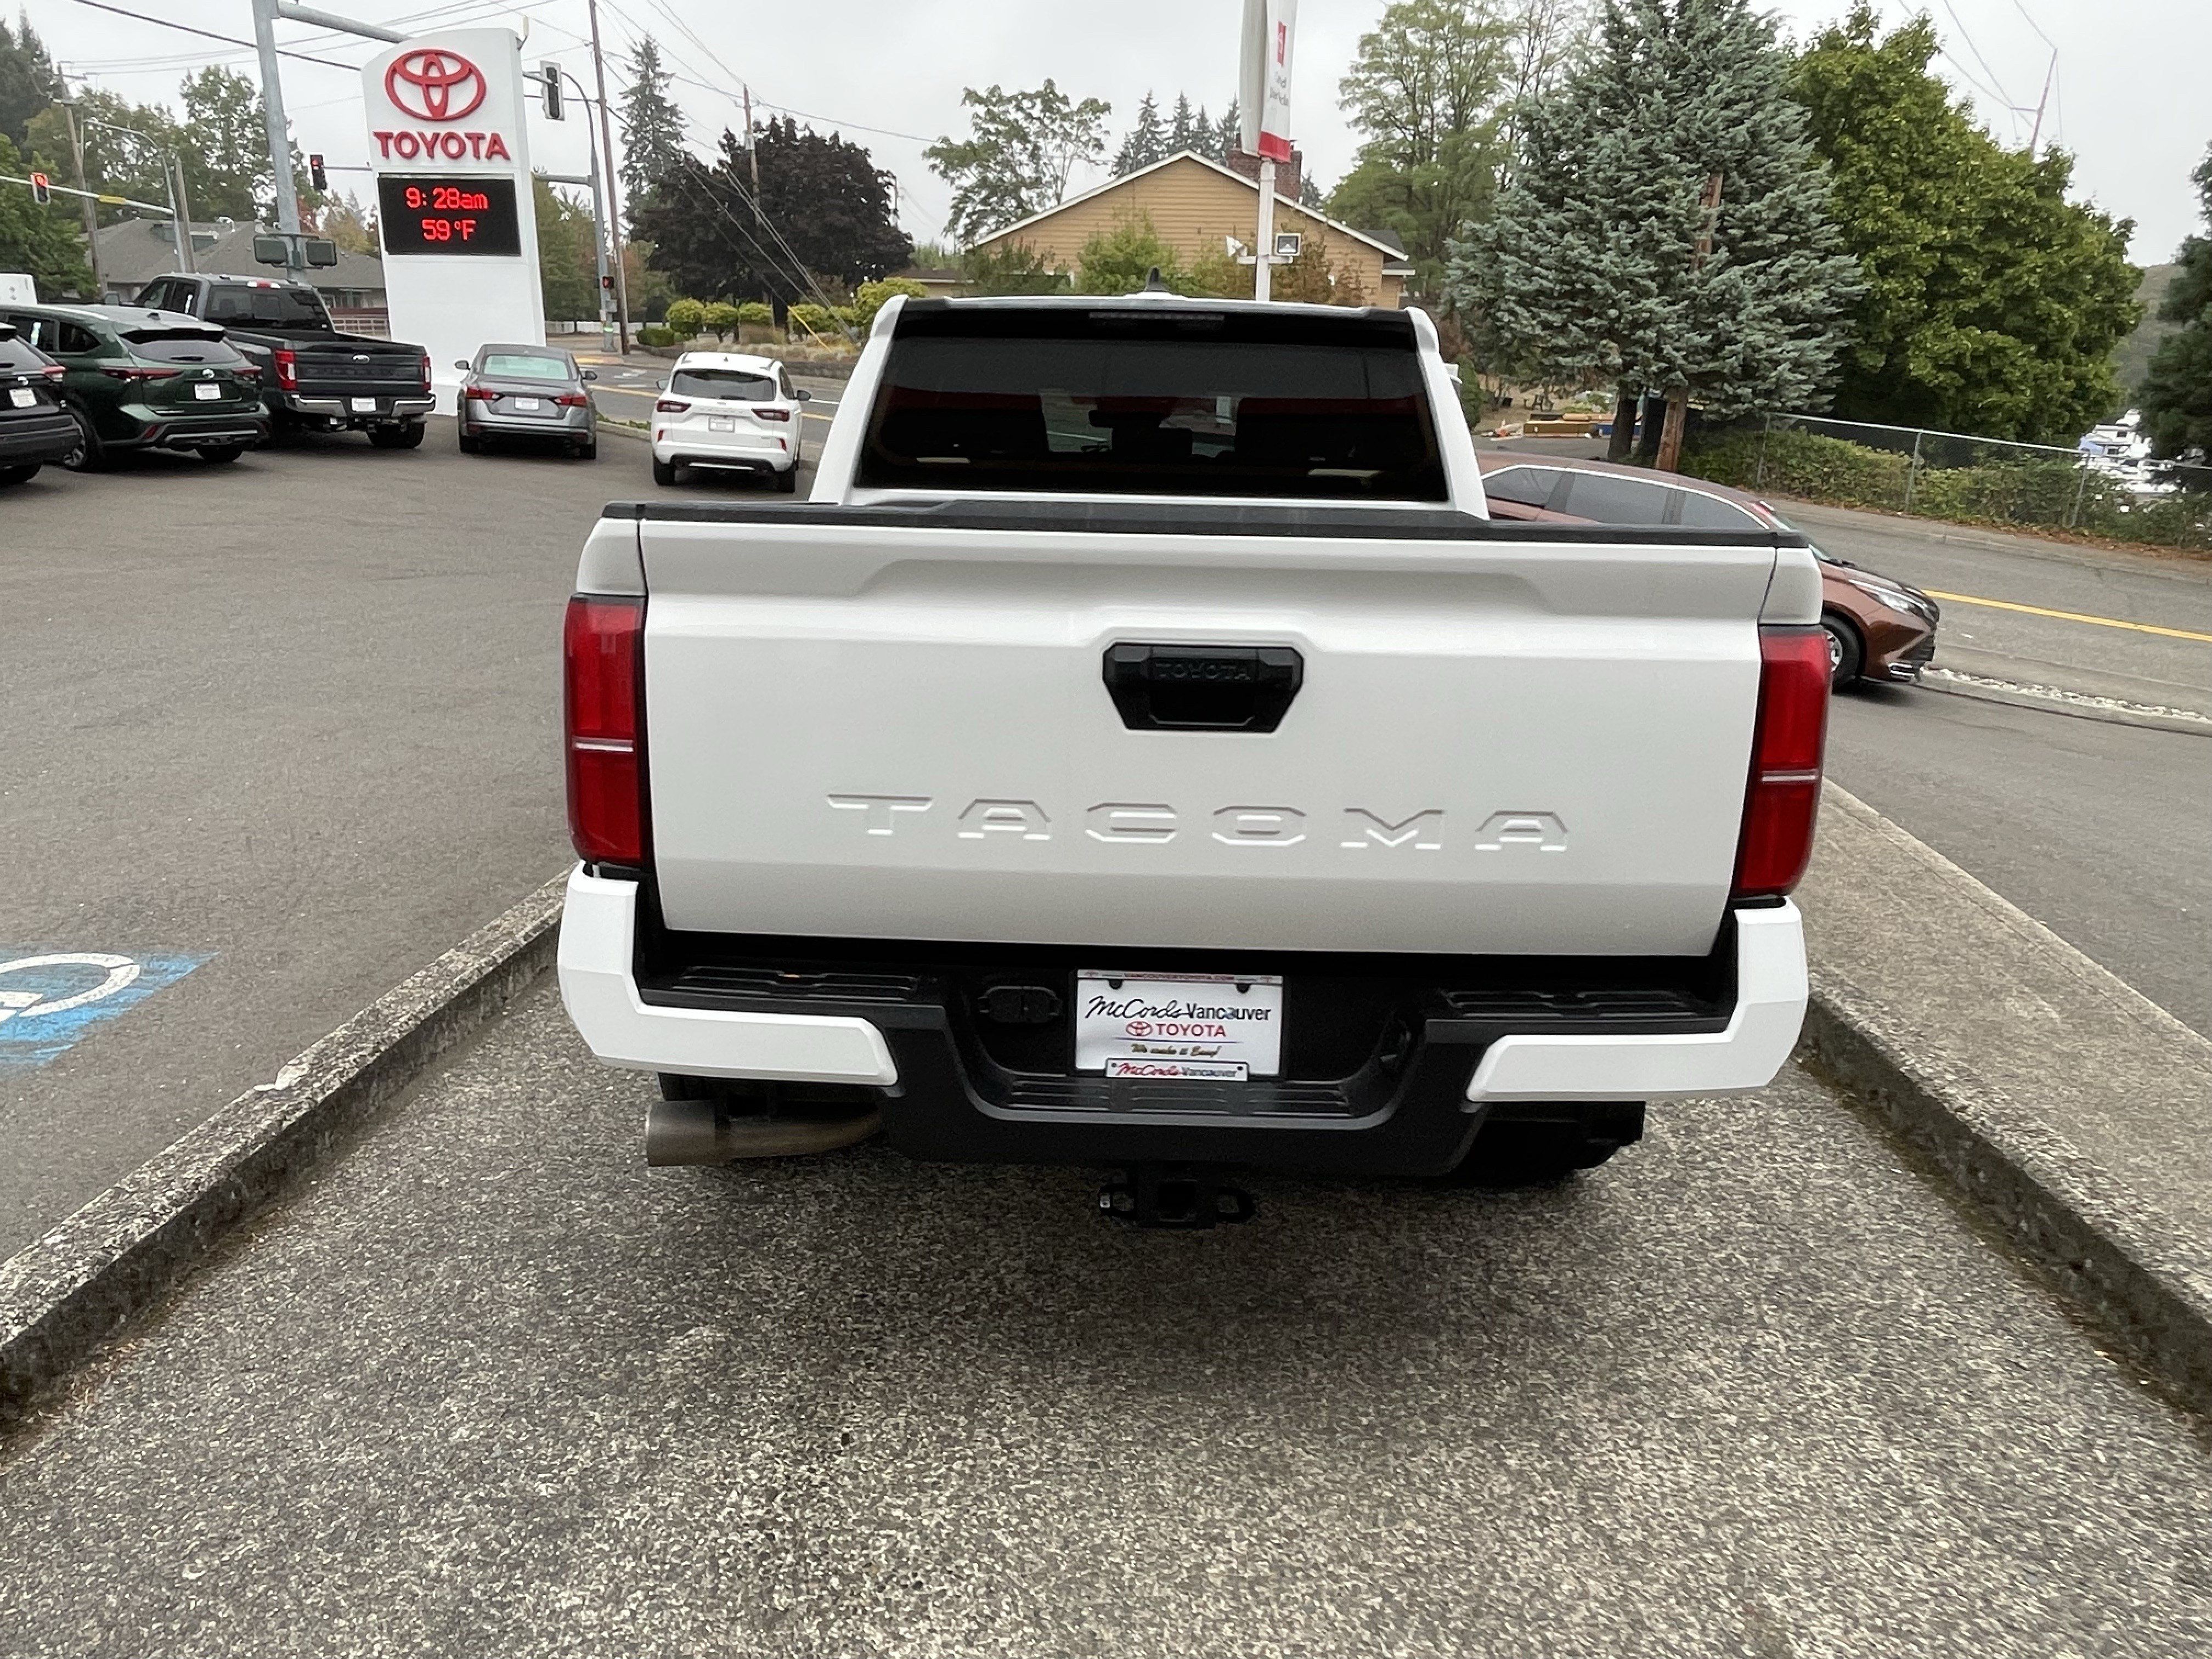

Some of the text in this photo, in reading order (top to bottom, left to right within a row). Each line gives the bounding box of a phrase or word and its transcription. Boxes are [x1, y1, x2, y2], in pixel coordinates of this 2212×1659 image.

[373, 131, 511, 161] TOYOTA
[405, 187, 489, 210] 9:28am
[1155, 663, 1251, 680] TOYOTA
[826, 793, 1568, 851] TACOMA
[1155, 1023, 1227, 1038] TOYOTA
